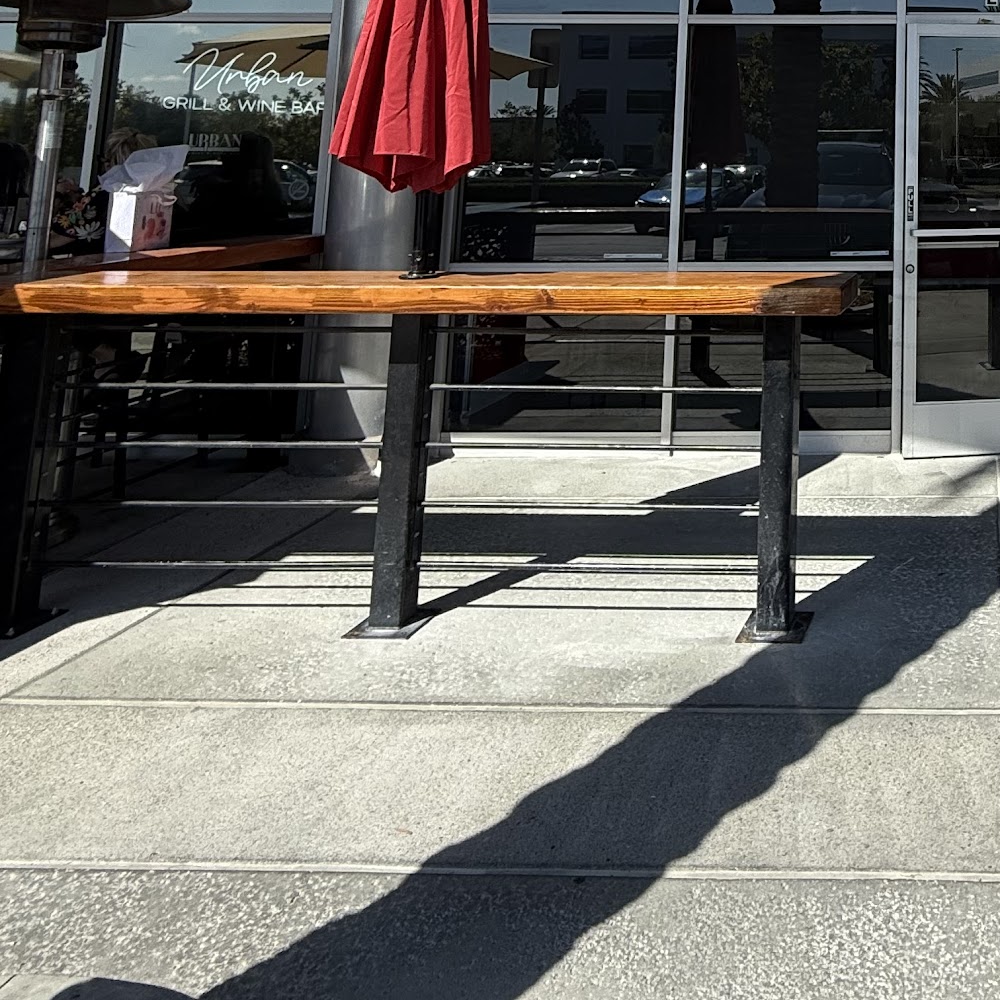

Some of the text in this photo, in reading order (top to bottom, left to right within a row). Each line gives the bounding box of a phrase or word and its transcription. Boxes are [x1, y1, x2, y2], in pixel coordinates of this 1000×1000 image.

[182, 48, 313, 94] Urban
[162, 96, 214, 111] GRILL
[218, 97, 232, 112] &
[237, 98, 287, 114] WINE
